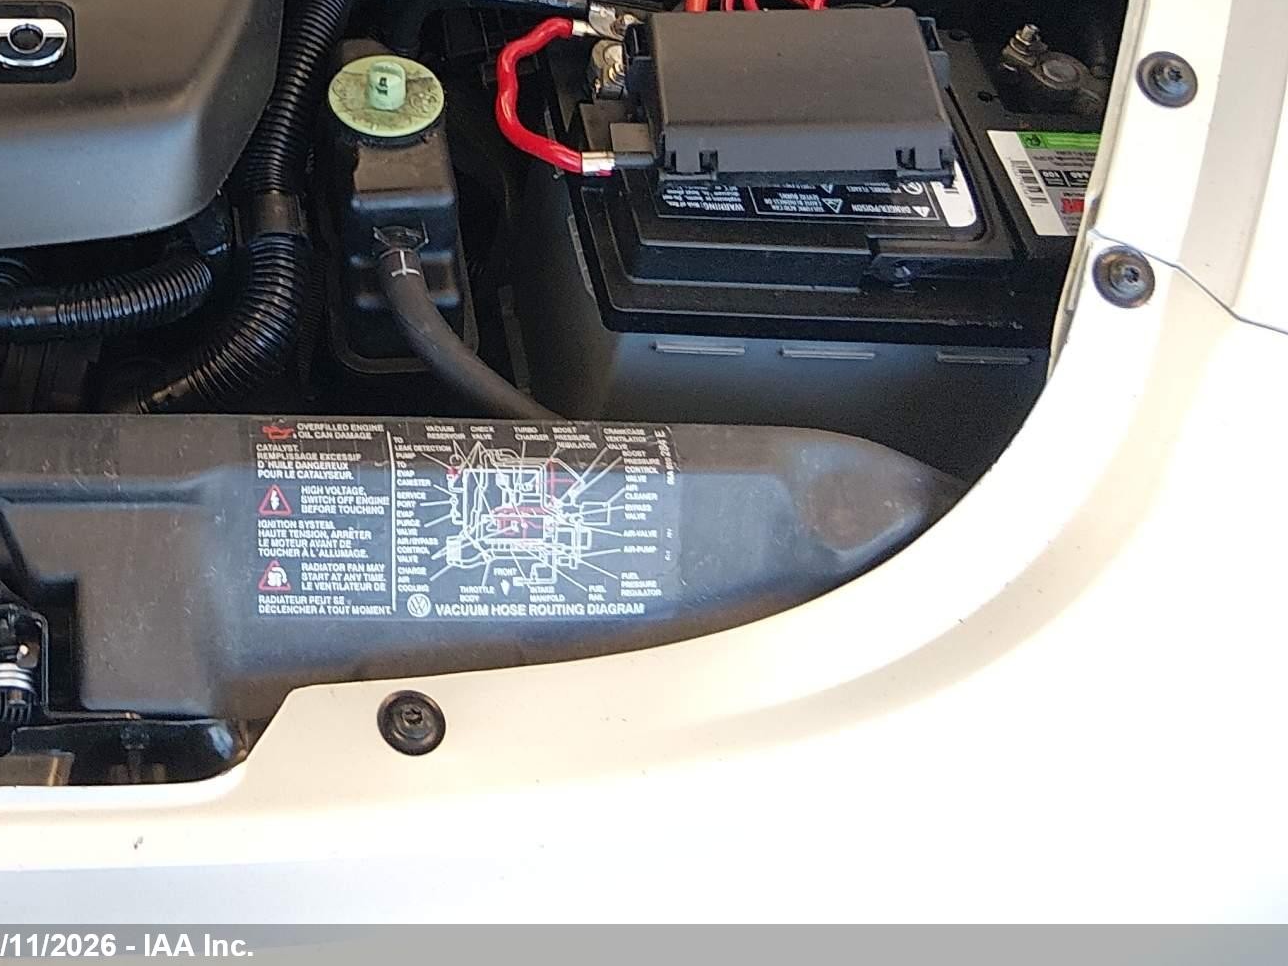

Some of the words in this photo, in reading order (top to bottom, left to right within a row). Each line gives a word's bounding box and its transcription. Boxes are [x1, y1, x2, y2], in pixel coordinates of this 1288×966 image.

[297, 422, 349, 432] OVERFILLED
[351, 424, 385, 433] ENGINE
[314, 432, 334, 440] CAN
[335, 432, 373, 440] DAMAGE
[256, 452, 318, 461] REMPLISSAGE
[295, 461, 349, 470] DANGEREUX
[257, 470, 284, 479] POUR
[284, 470, 296, 479] LE
[300, 486, 324, 495] HIGH
[300, 496, 336, 504] SWITCH
[338, 496, 354, 504] OFF
[356, 496, 390, 506] ENGINE
[301, 505, 337, 514] BEFORE
[338, 506, 385, 515] TOUCHING
[258, 520, 297, 529] IGNITION
[258, 530, 288, 538] HAUTE
[330, 526, 372, 540] ARRÊTER
[258, 539, 270, 548] LE
[271, 539, 308, 548] MOTEUR
[309, 539, 338, 548] AVANT
[339, 540, 352, 549] DE
[258, 548, 300, 558] TOUCHER
[301, 562, 346, 572] RADIATOR
[347, 563, 365, 572] FAN
[366, 563, 386, 572] MAY
[494, 568, 518, 576] FRONT
[302, 572, 330, 582] START
[331, 572, 343, 582] AT
[344, 572, 362, 582] ANY
[302, 582, 315, 591] LE
[316, 582, 372, 592] VENTILATEUR
[374, 582, 386, 592] DE
[258, 594, 308, 604] RADIATEUR
[308, 595, 332, 605] PEUT
[332, 596, 345, 605] SE
[326, 605, 350, 615] TOUT
[435, 604, 489, 616] VACUUM
[491, 604, 528, 616] HOSE
[528, 603, 586, 616] ROUTING
[587, 602, 646, 616] DIAGRAM
